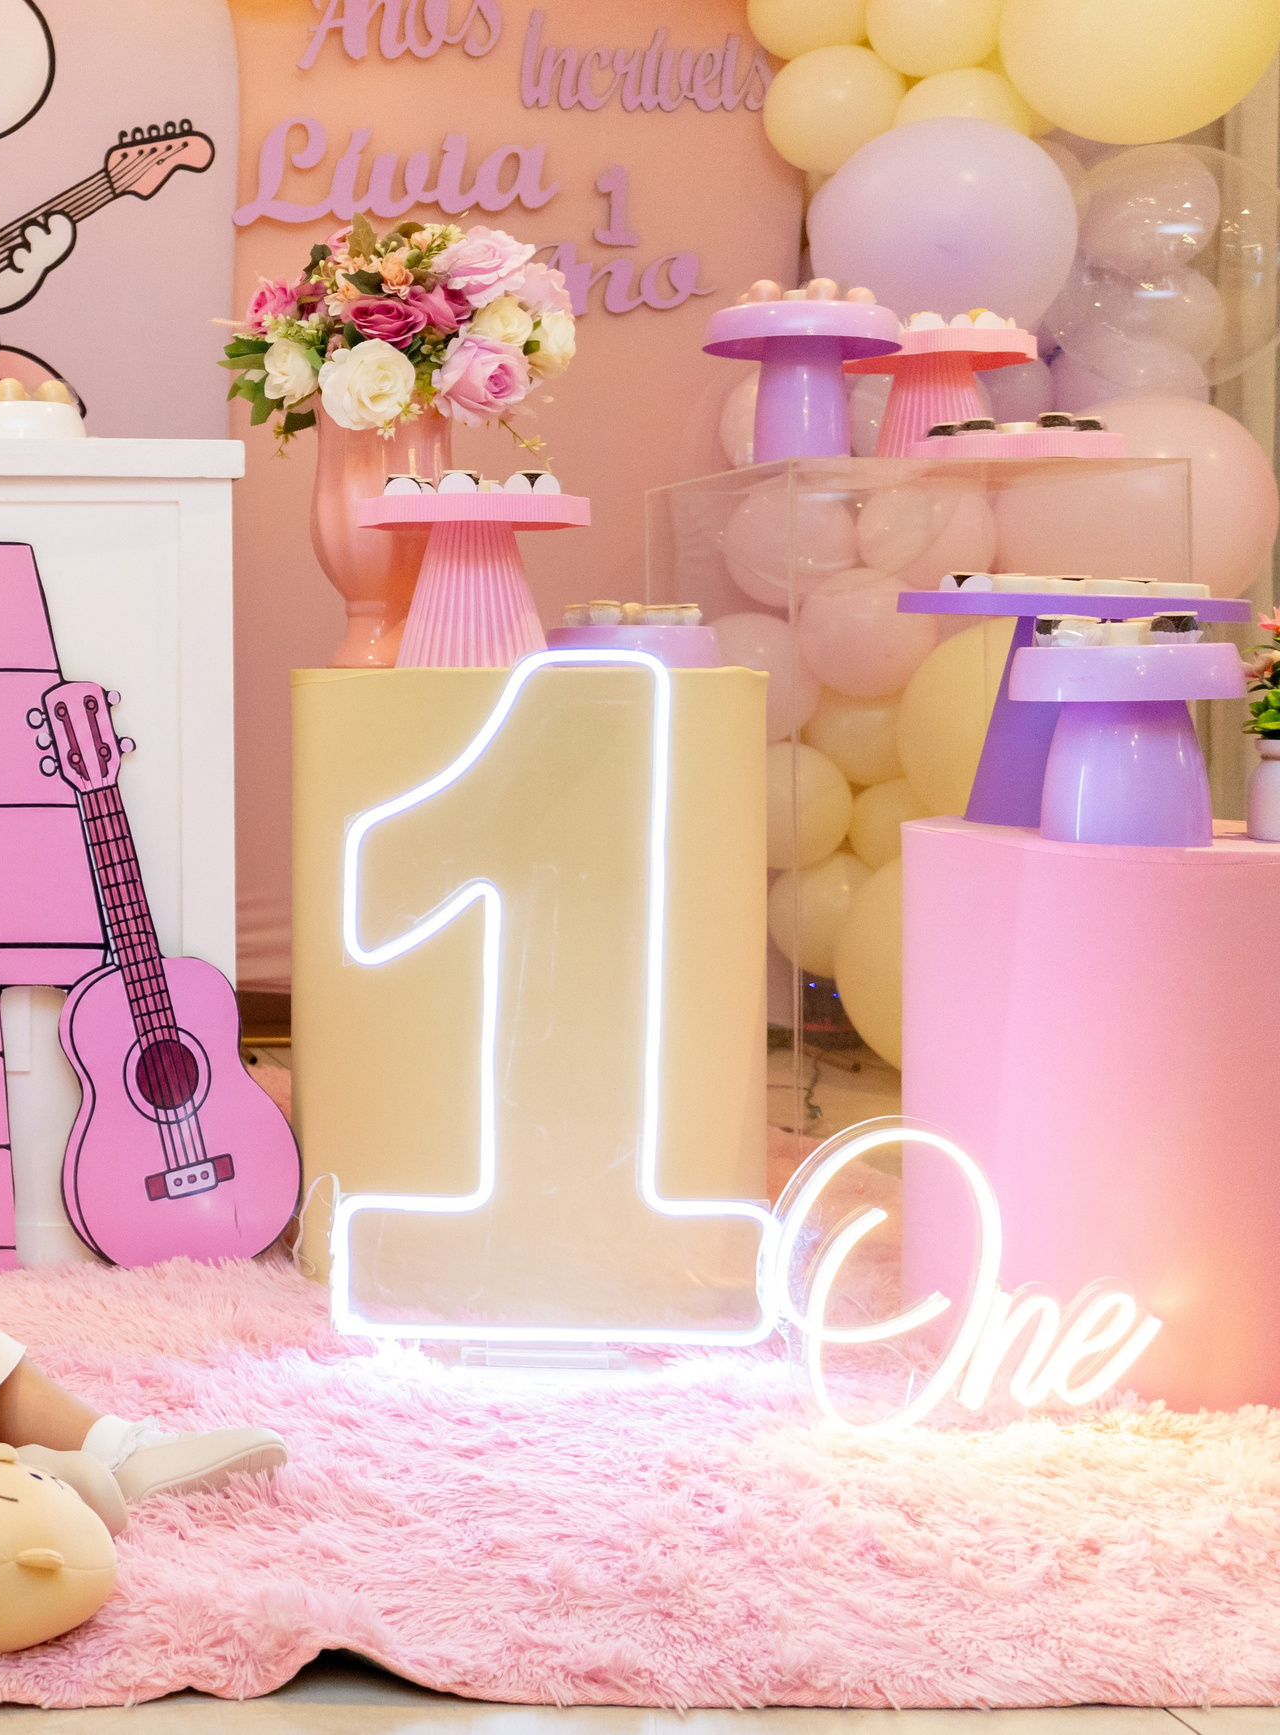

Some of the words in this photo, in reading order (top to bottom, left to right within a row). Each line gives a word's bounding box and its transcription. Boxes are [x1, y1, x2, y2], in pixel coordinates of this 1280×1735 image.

[232, 116, 560, 227] Lívia
[594, 165, 640, 247] 1
[330, 646, 780, 1347] 1
[773, 1120, 1163, 1431] One
